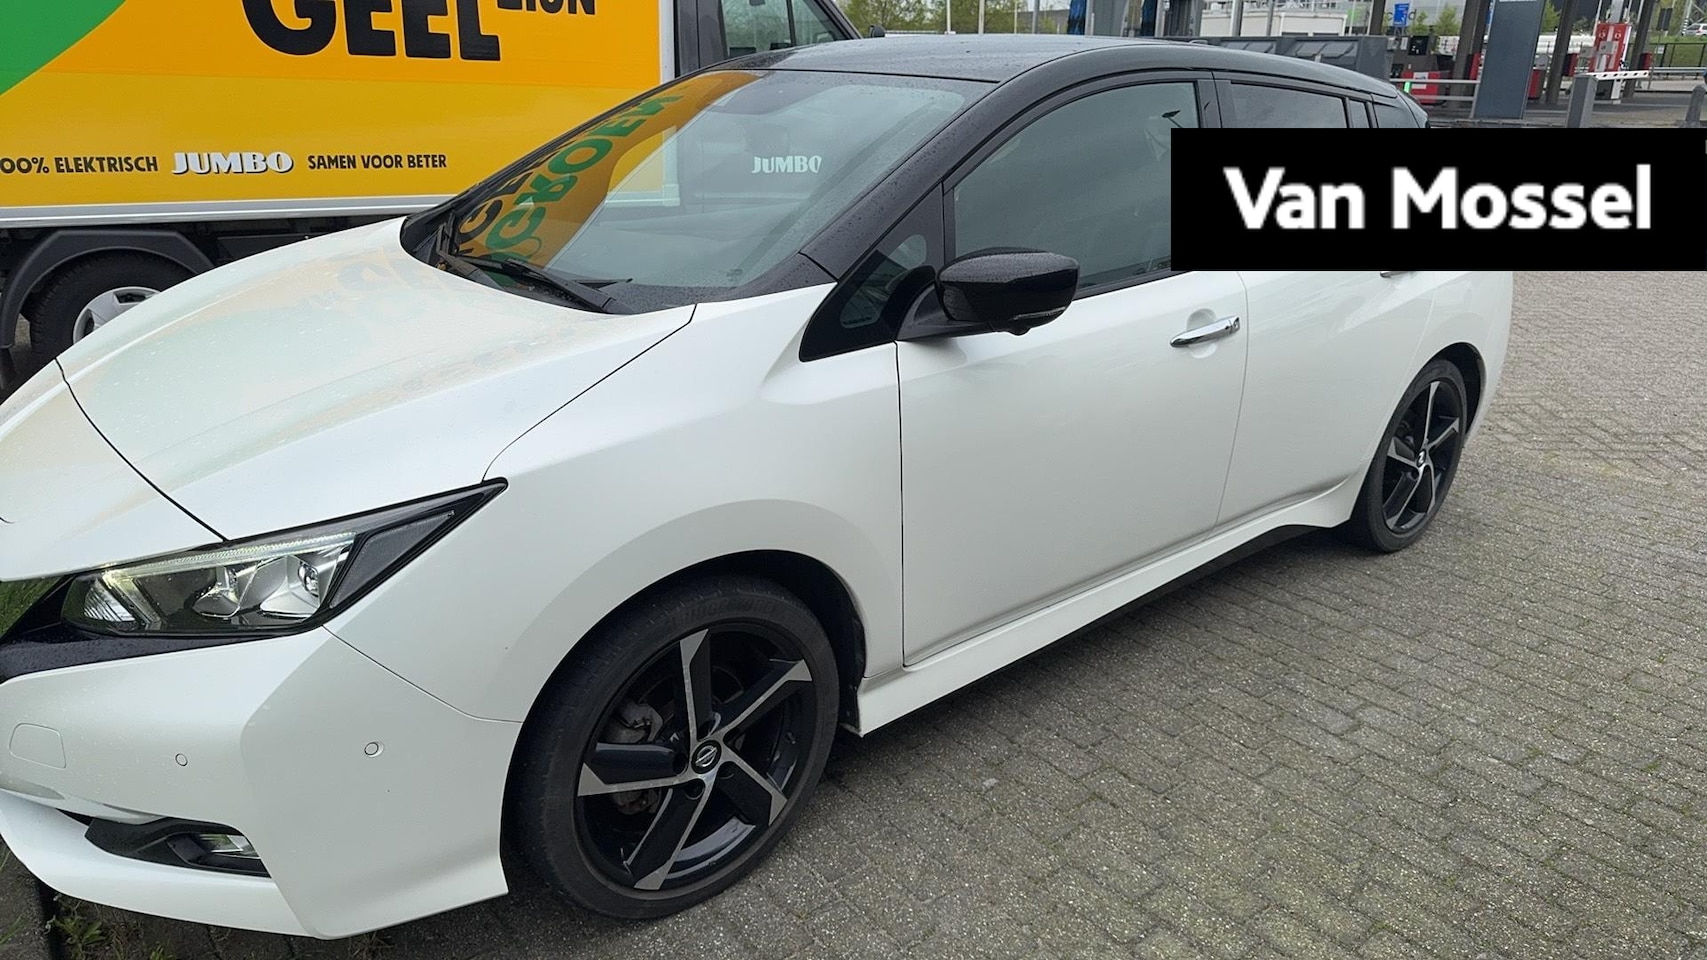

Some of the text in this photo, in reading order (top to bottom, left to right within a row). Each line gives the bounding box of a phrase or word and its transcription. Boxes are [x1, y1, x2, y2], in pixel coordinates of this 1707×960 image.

[54, 156, 158, 173] ELEKTRISCH
[171, 151, 294, 174] JUMBO
[307, 154, 447, 170] SAMEN VOOR BETER
[751, 155, 823, 173] JUMBO
